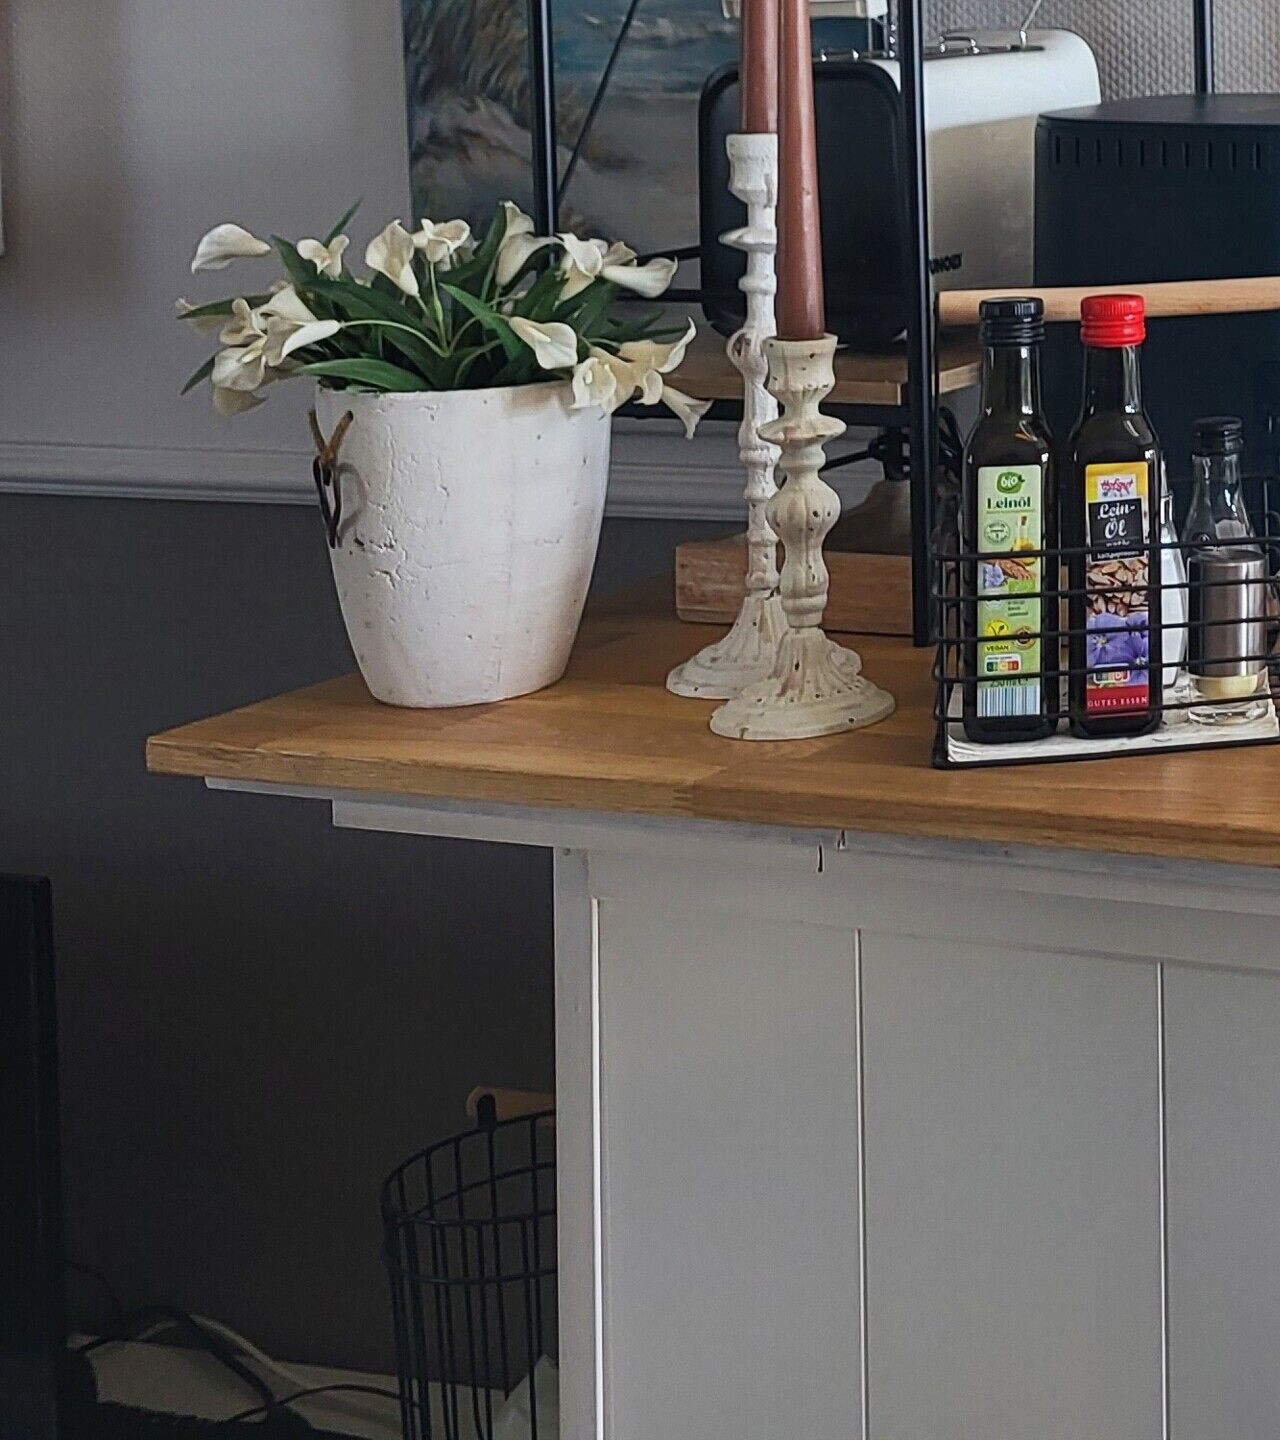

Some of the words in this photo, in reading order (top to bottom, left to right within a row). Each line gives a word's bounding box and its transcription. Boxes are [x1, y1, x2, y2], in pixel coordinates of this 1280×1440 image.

[986, 495, 1031, 510] Leinöl
[1104, 517, 1127, 539] Öl
[986, 644, 1010, 653] VEGAN
